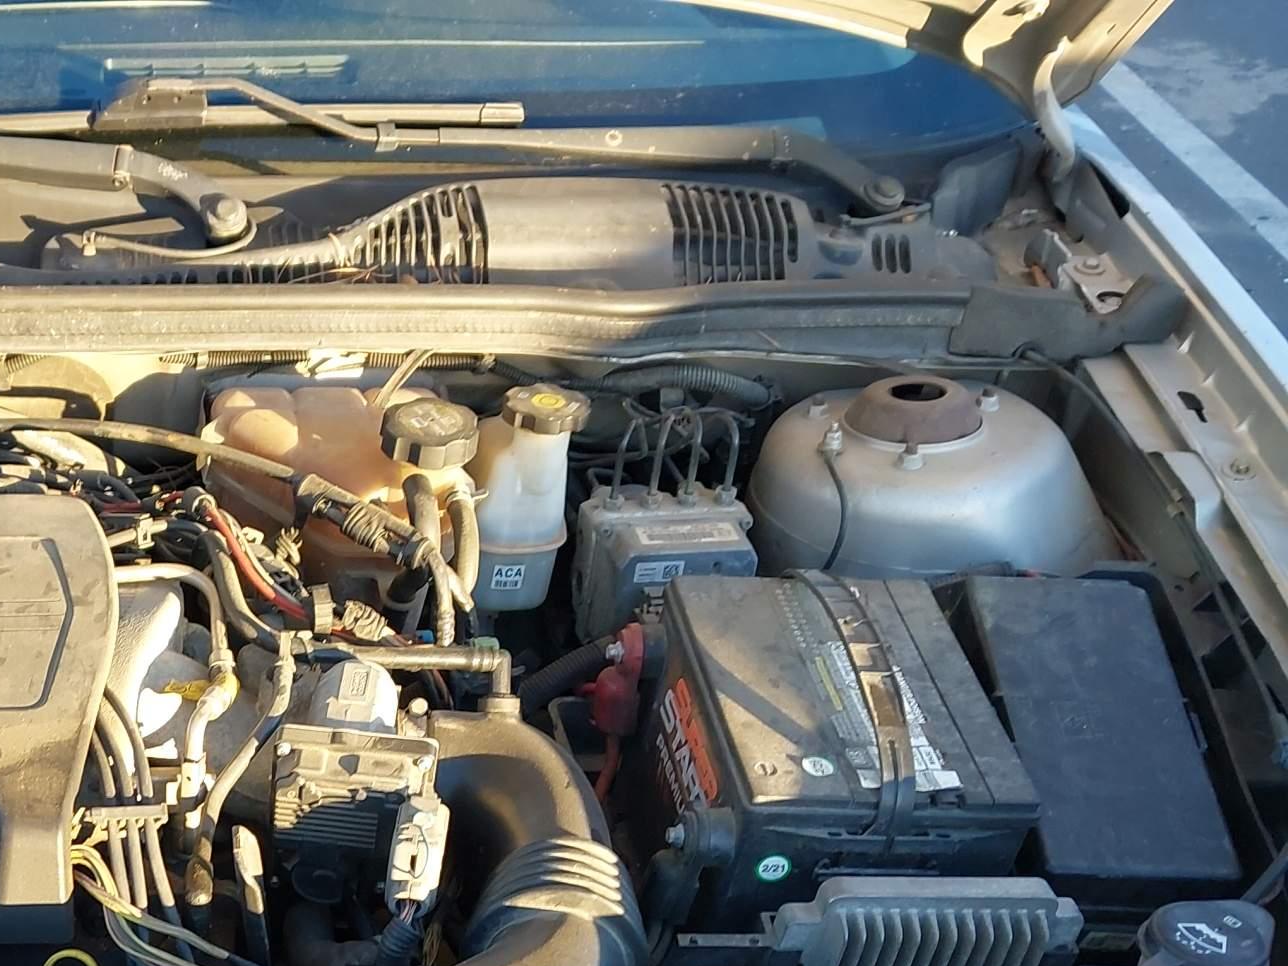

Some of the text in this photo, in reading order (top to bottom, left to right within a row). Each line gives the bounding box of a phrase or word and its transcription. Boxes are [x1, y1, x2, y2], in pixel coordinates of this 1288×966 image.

[495, 568, 522, 577] ACA
[655, 732, 686, 816] PREMIU
[761, 863, 786, 873] 2/21
